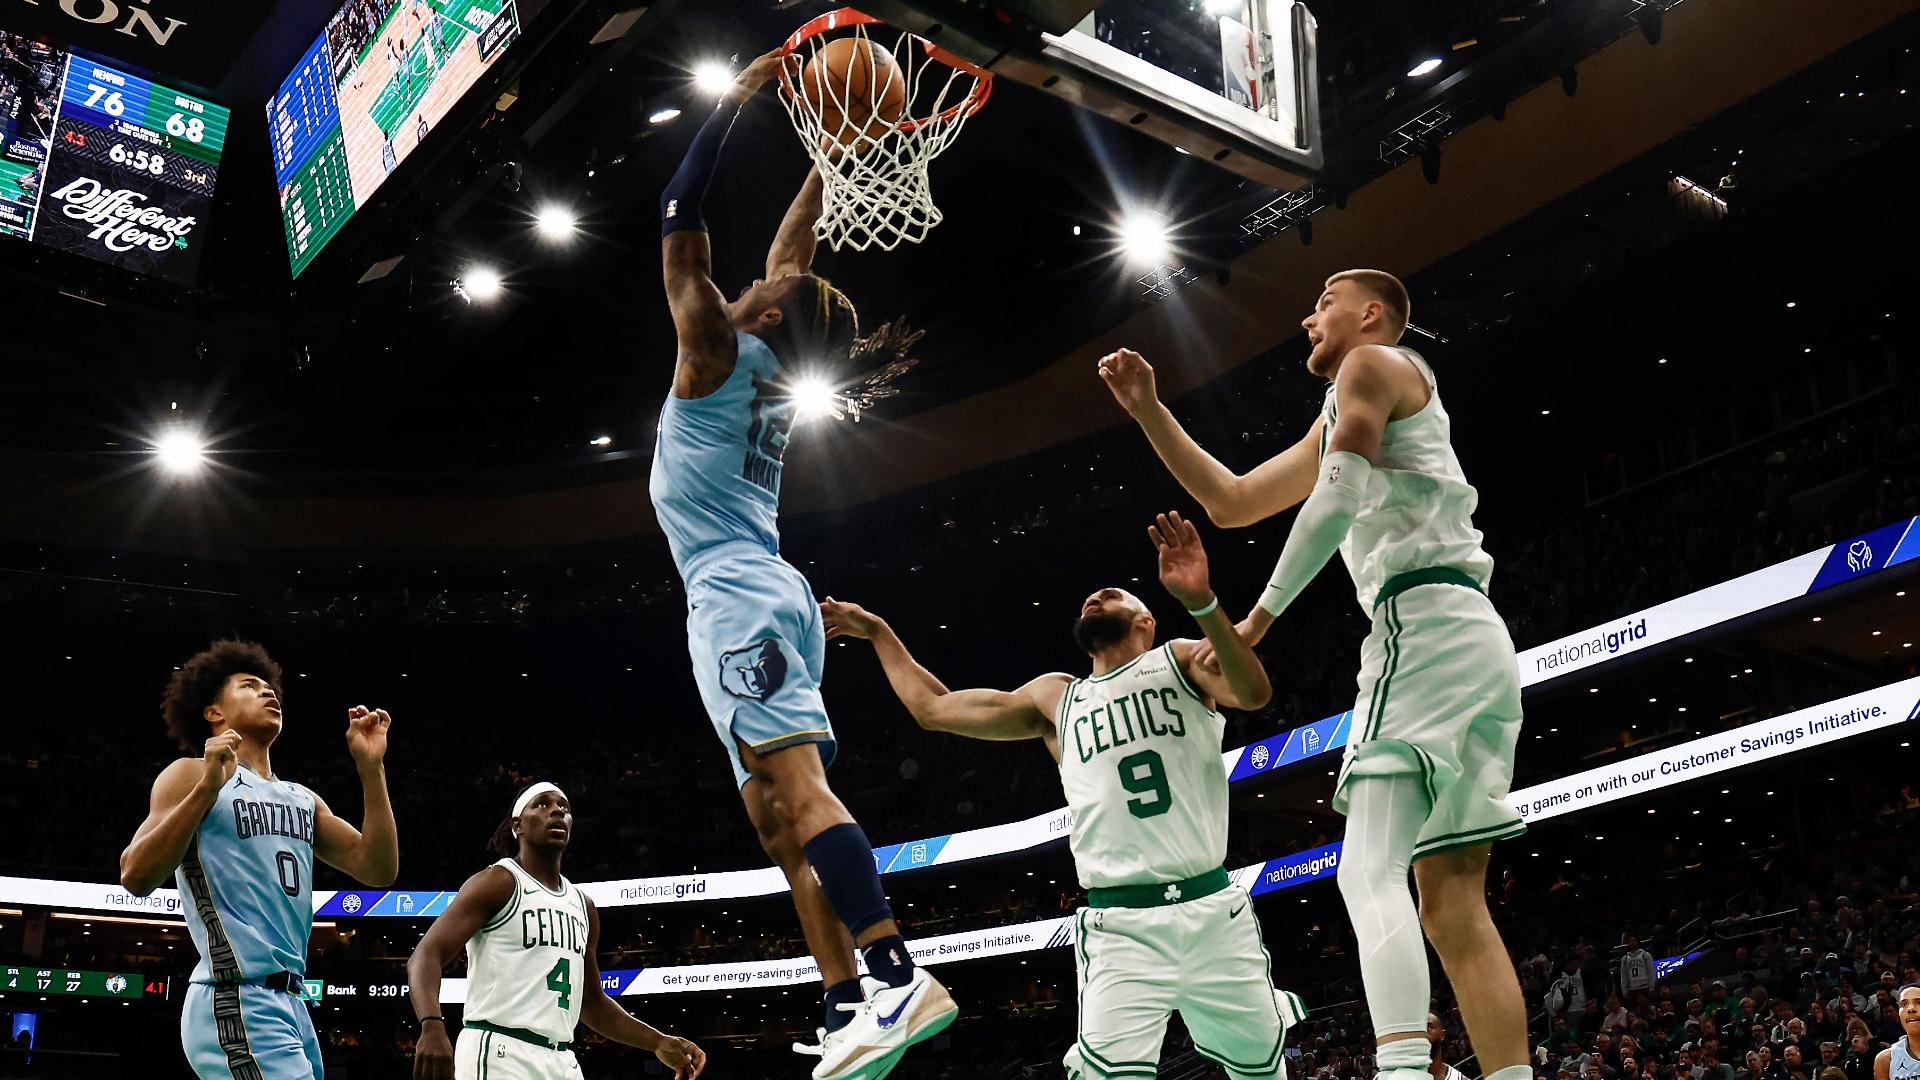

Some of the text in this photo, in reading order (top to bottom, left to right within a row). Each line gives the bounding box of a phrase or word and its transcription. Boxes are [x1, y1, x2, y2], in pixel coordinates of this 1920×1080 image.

[23, 0, 187, 45] ON
[84, 83, 124, 117] 76
[65, 131, 88, 146] 4.3
[165, 113, 205, 143] 68
[109, 143, 164, 175] 6:58
[184, 169, 207, 185] 3rd
[50, 176, 196, 236] Different
[87, 215, 175, 251] Here
[1536, 618, 1647, 673] nationalgrid
[1074, 687, 1186, 763] CELTICS
[1533, 793, 1571, 813] game
[1575, 786, 1593, 798] on
[1597, 776, 1628, 793] with
[1632, 768, 1656, 783] our
[1660, 744, 1736, 775] Customer
[1740, 727, 1804, 754] Savings
[1808, 705, 1887, 735] Initiative.
[1117, 749, 1173, 819] 9
[275, 850, 300, 897] 0
[1266, 851, 1337, 885] nationalgrid
[105, 890, 182, 911] nationalgr
[620, 879, 706, 899] nationalgrid
[910, 932, 1034, 958] omer Savings Initiative.
[8, 978, 81, 992] 4 17 27
[145, 982, 164, 994] 4.1
[327, 985, 357, 995] Bank
[368, 985, 397, 997] 9:30
[401, 985, 410, 997] P
[546, 957, 571, 1010] 4
[662, 974, 682, 985] Get
[685, 974, 711, 986] your
[713, 967, 793, 984] energy-saving
